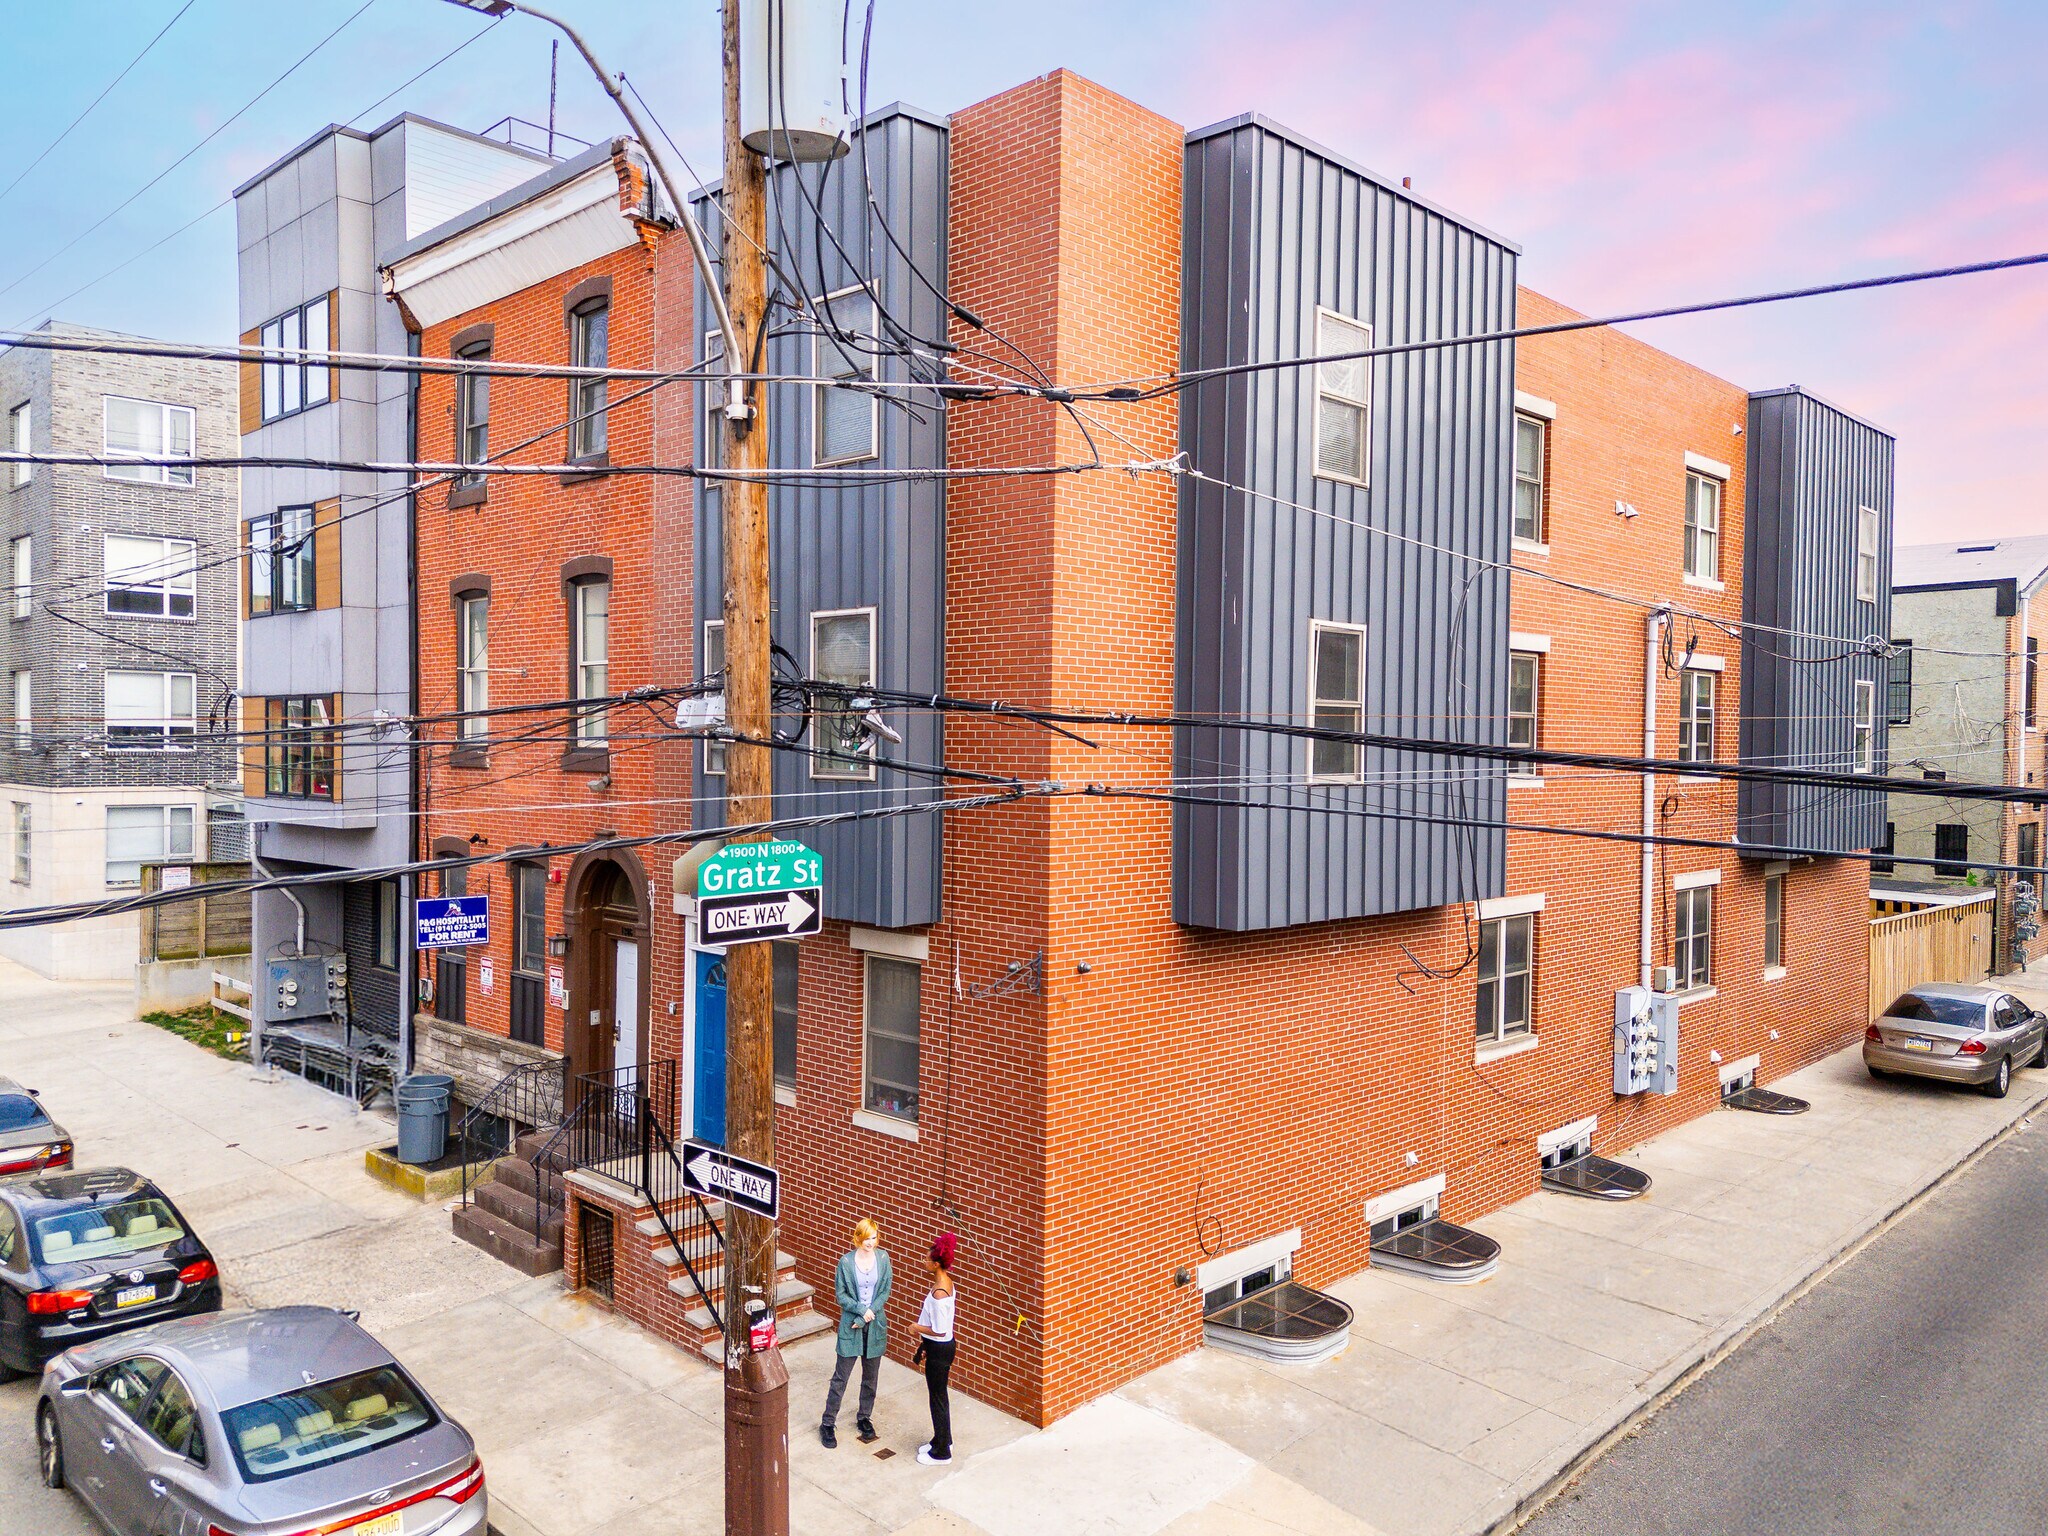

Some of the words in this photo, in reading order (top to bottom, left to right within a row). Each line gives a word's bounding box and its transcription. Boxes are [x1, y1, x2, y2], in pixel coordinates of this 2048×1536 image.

[729, 847, 756, 858] 1900
[757, 843, 769, 858] N
[770, 843, 796, 855] 1800
[703, 861, 781, 891] Gratz
[793, 859, 819, 883] St
[419, 918, 436, 927] P&G
[436, 914, 487, 926] HOSPITALITY
[714, 909, 748, 929] ONE
[754, 904, 787, 925] WAY
[428, 932, 450, 942] FOR
[450, 930, 478, 940] RENT
[435, 925, 453, 933] (914)
[711, 1165, 737, 1189] ONE
[741, 1174, 768, 1199] WAY
